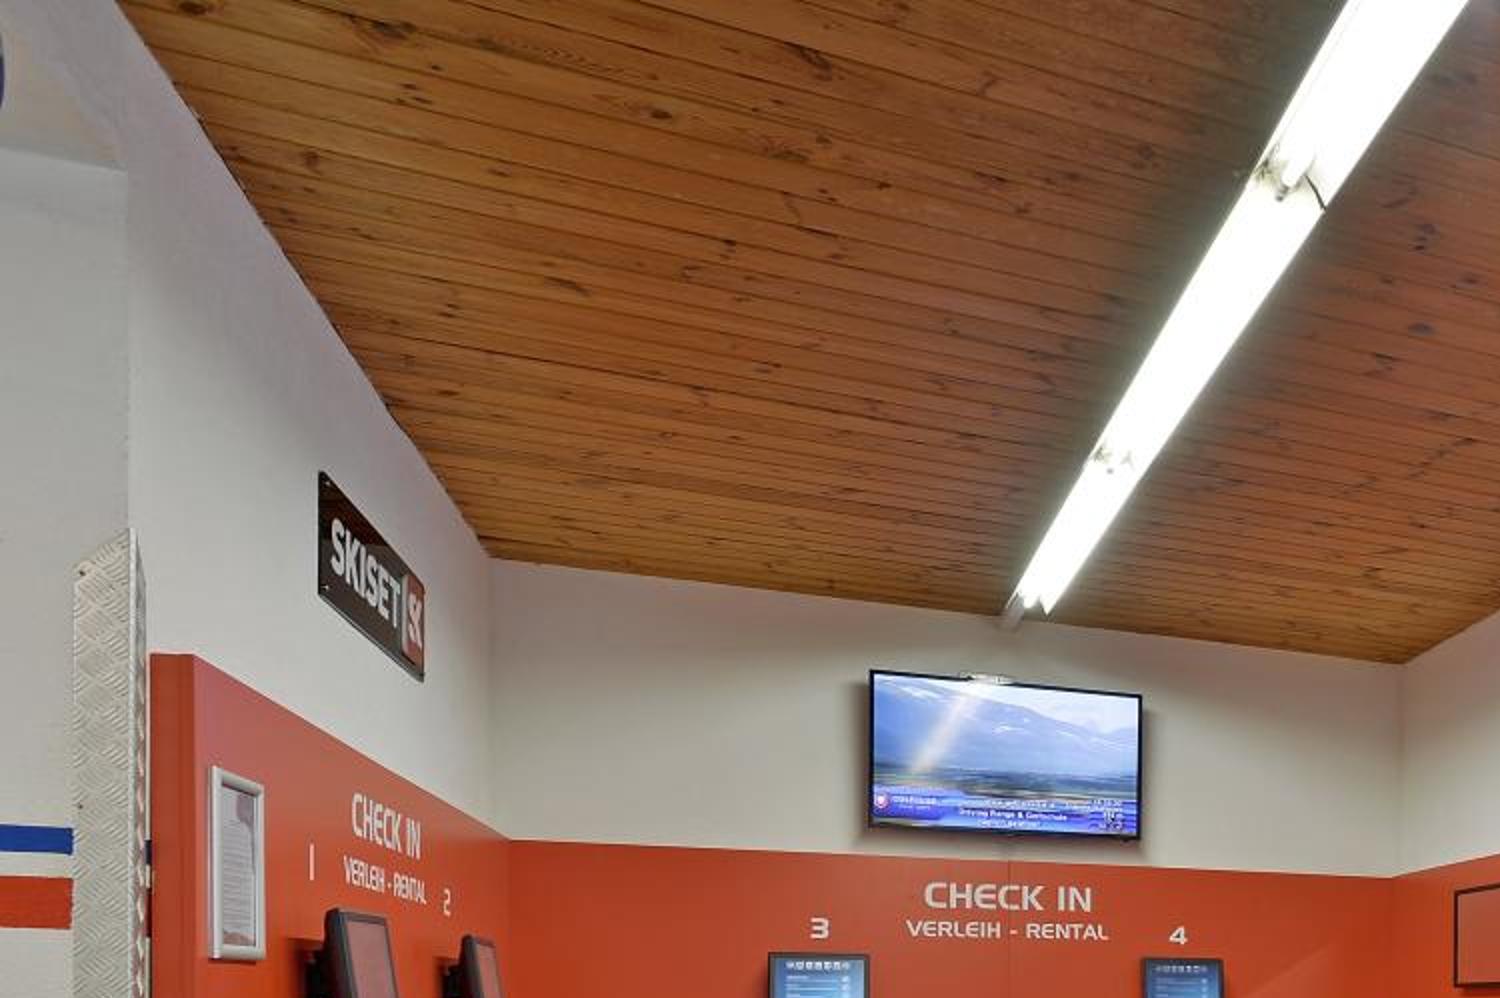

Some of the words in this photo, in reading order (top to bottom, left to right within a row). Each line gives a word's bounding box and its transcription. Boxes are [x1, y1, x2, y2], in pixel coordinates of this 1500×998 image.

[331, 518, 400, 628] SKISET
[352, 793, 403, 854] CHECK
[406, 817, 421, 860] IN
[343, 855, 385, 894] VERLEIH
[393, 872, 427, 905] RENTAL
[443, 888, 451, 917] 2
[924, 882, 1044, 911] CHECK
[1058, 886, 1092, 912] IN
[810, 918, 831, 940] 3
[906, 920, 1001, 939] VERLEIH
[1025, 922, 1109, 942] RENTAL
[1168, 926, 1188, 945] 4
